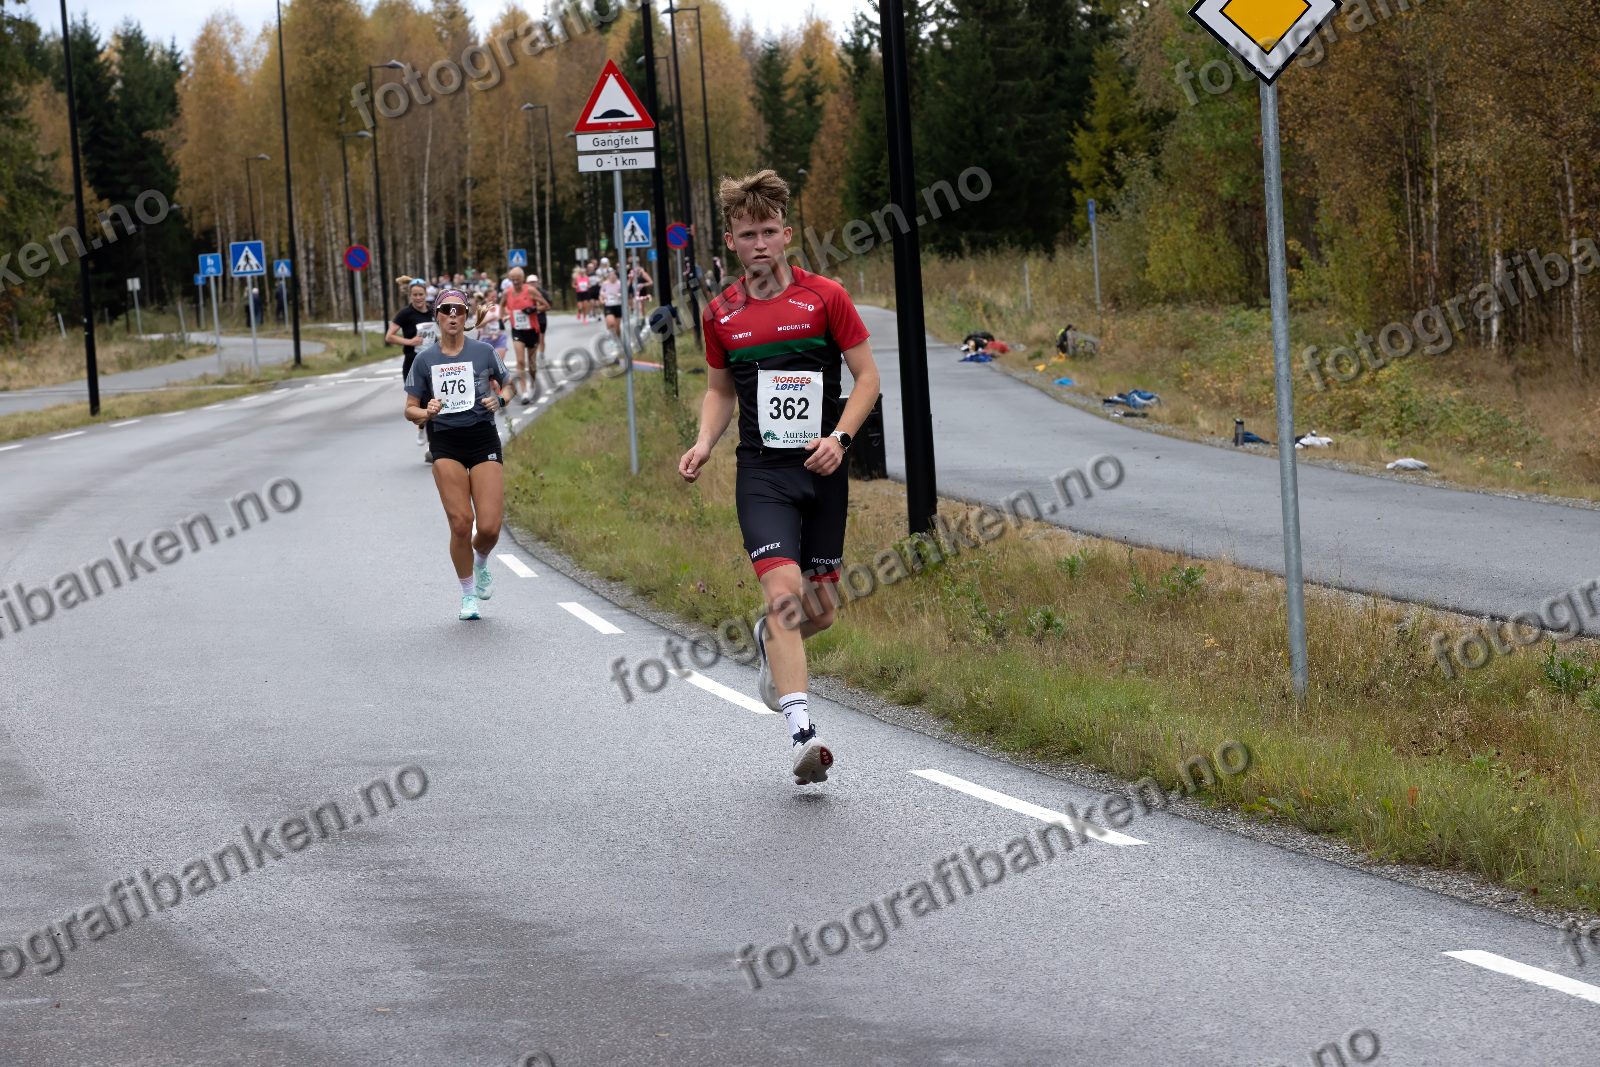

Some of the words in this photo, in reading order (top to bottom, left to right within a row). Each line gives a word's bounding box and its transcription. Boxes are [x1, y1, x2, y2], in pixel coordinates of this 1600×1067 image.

[592, 136, 639, 148] Gangfelt
[596, 158, 604, 167] 0
[622, 157, 638, 166] km
[772, 376, 811, 384] NORGES
[440, 379, 466, 395] 476
[769, 397, 810, 420] 362
[783, 431, 819, 439] Aurskog
[751, 542, 781, 559] TRIMTEX
